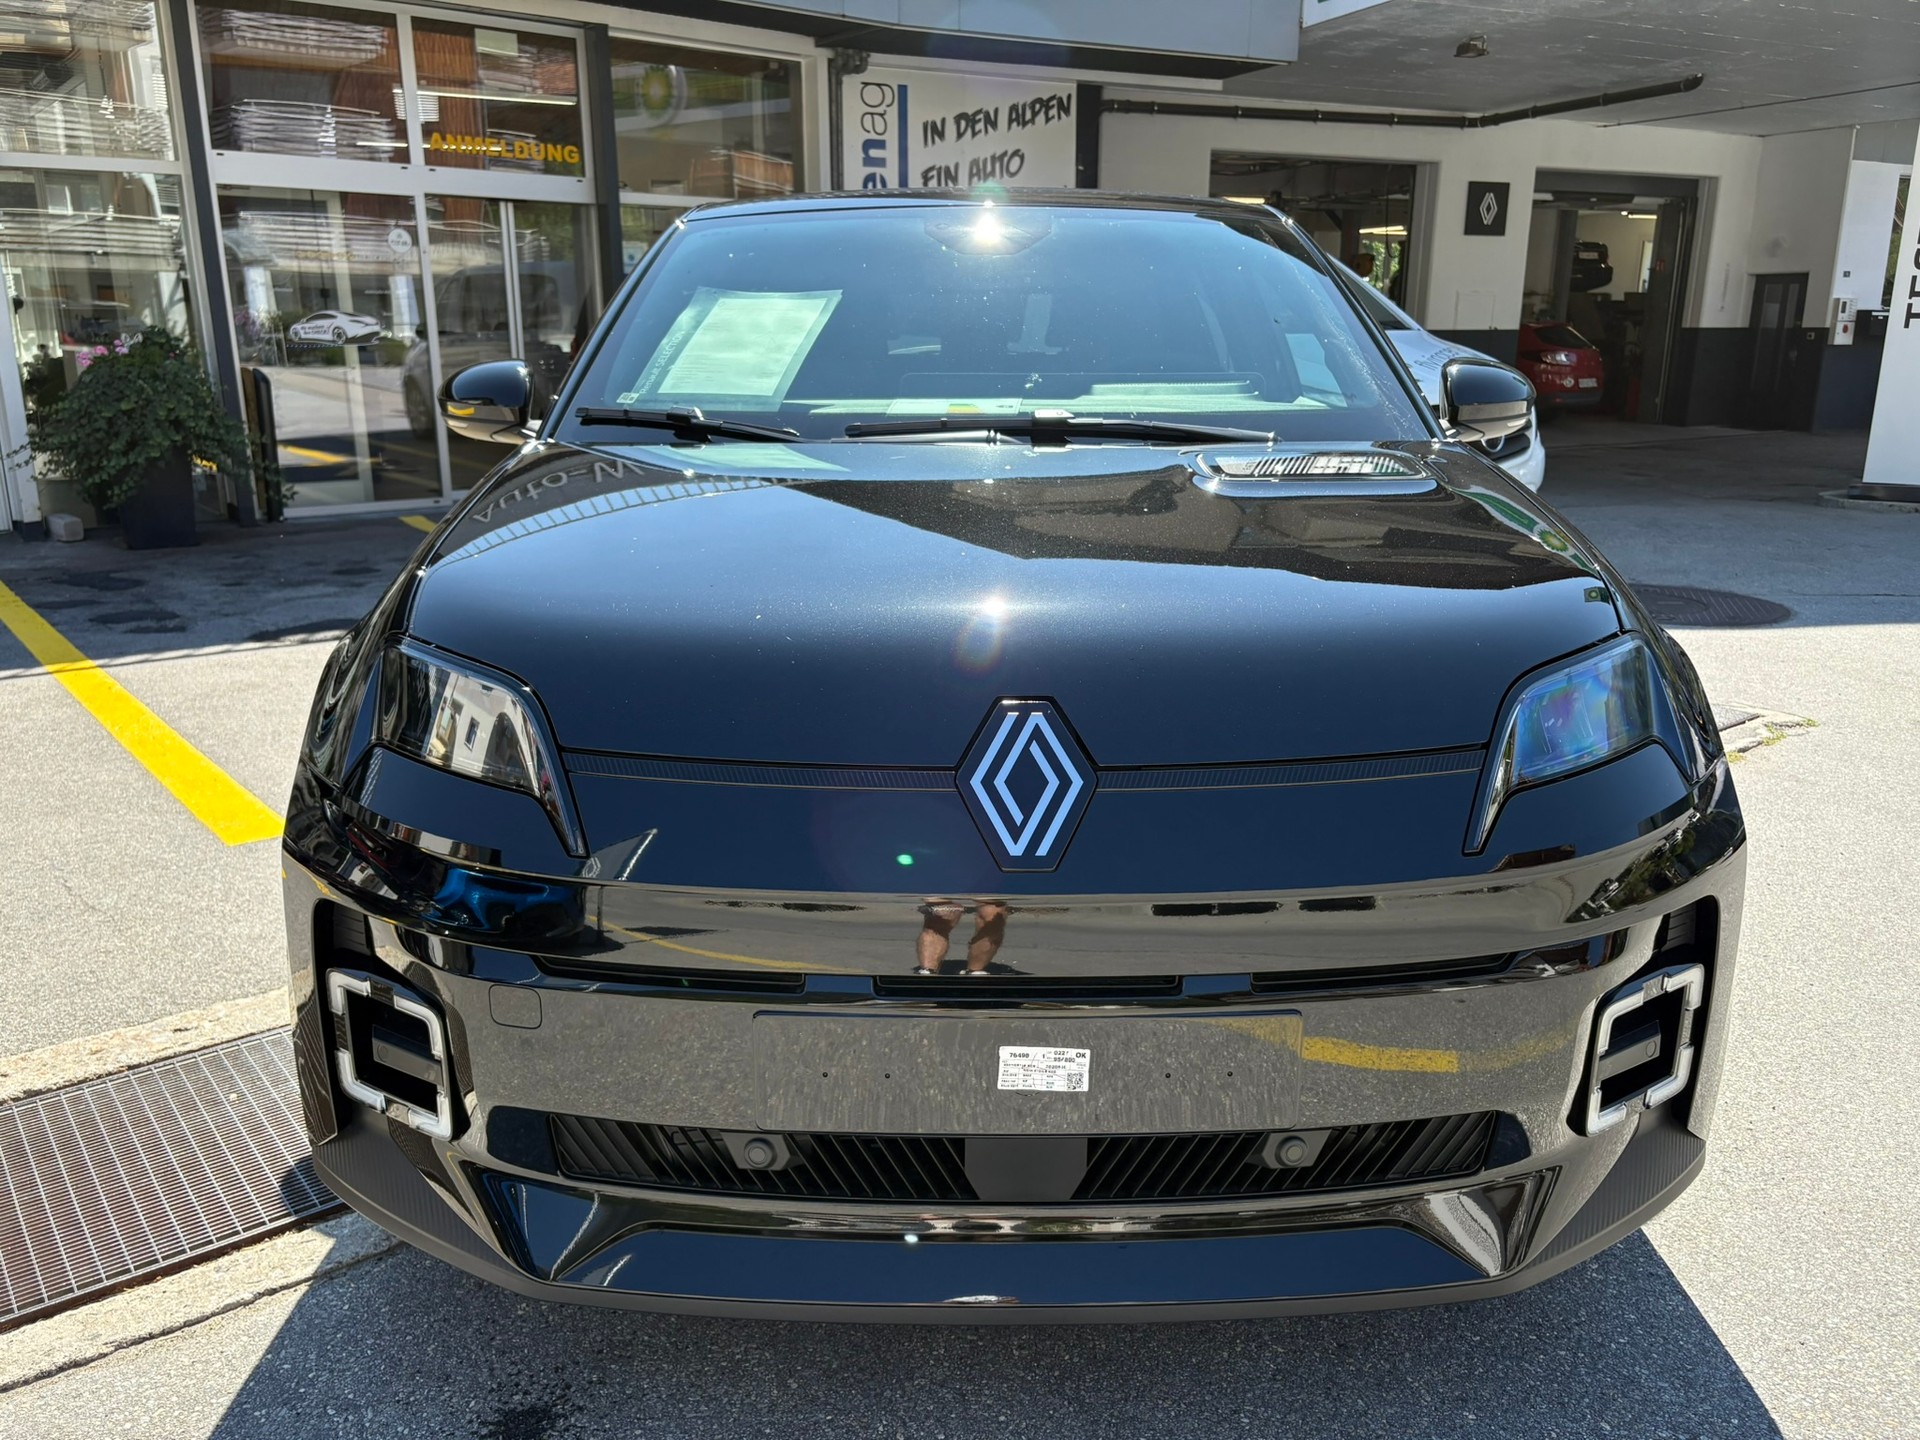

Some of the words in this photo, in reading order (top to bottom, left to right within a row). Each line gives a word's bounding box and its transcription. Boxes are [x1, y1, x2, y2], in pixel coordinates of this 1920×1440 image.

[922, 117, 946, 149] IN
[953, 107, 999, 143] DEN
[1007, 93, 1072, 133] ALPEN
[429, 132, 580, 164] ANMELDUNG
[968, 148, 1025, 187] AUTO
